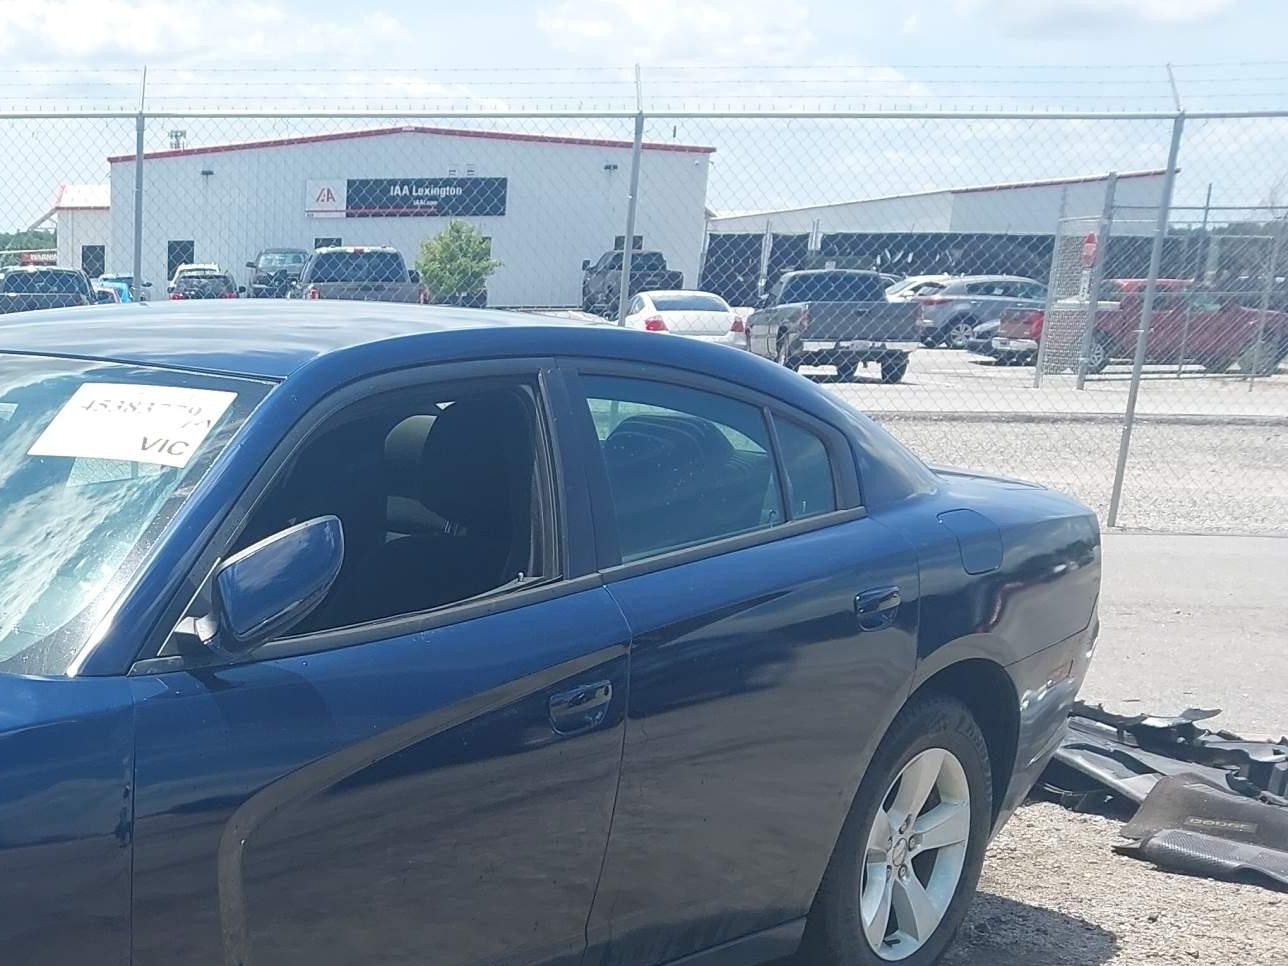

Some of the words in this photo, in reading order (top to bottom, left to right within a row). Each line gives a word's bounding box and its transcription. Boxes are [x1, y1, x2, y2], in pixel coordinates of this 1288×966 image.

[390, 185, 410, 197] IAA
[412, 184, 463, 198] Lexington
[140, 436, 190, 456] VIC
